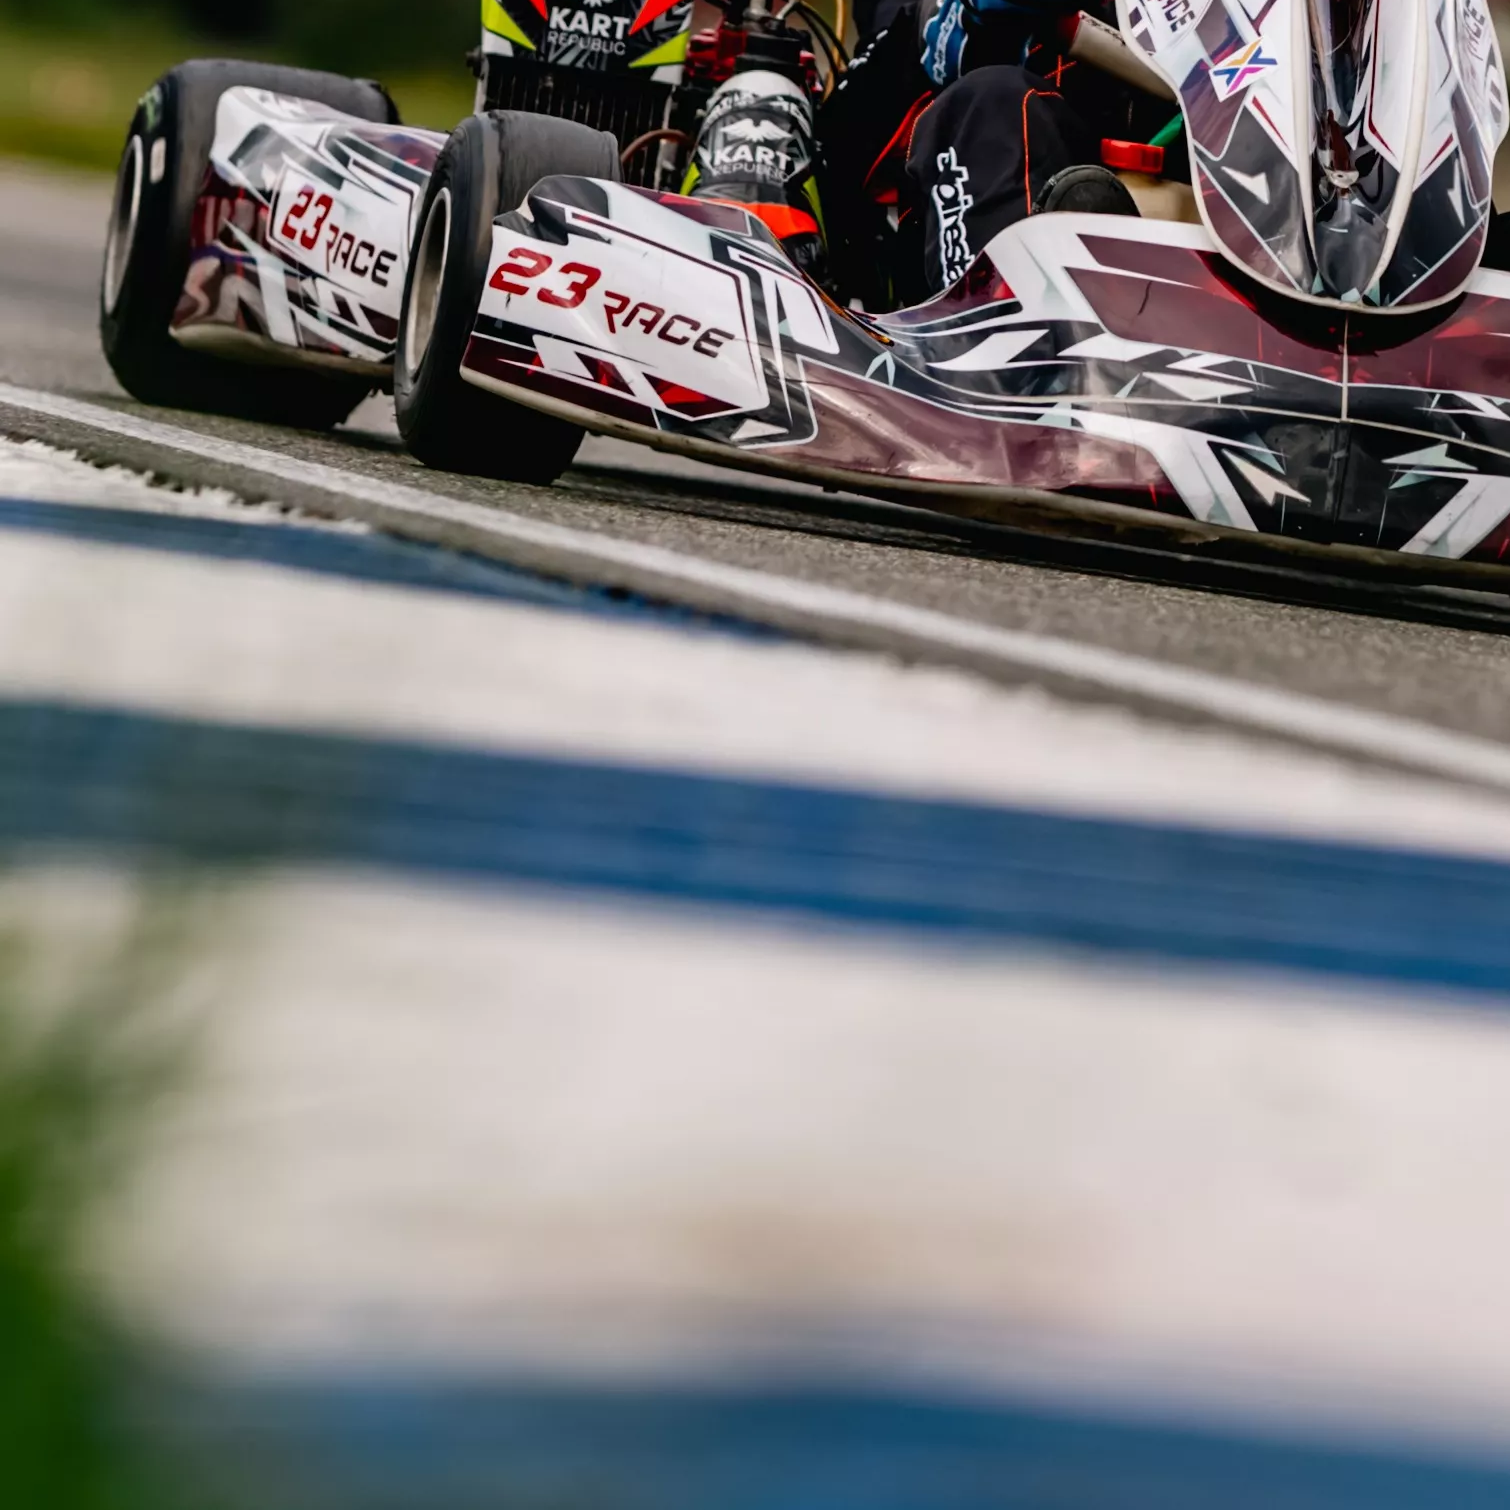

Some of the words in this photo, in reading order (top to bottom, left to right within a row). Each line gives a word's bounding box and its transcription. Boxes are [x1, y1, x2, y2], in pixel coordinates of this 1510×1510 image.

[548, 5, 631, 41] KART
[546, 31, 627, 56] REPUBLIC
[713, 144, 792, 171] KART
[281, 183, 334, 251] 23
[325, 222, 398, 288] RACE
[488, 246, 603, 310] 23
[603, 290, 736, 359] RACE
